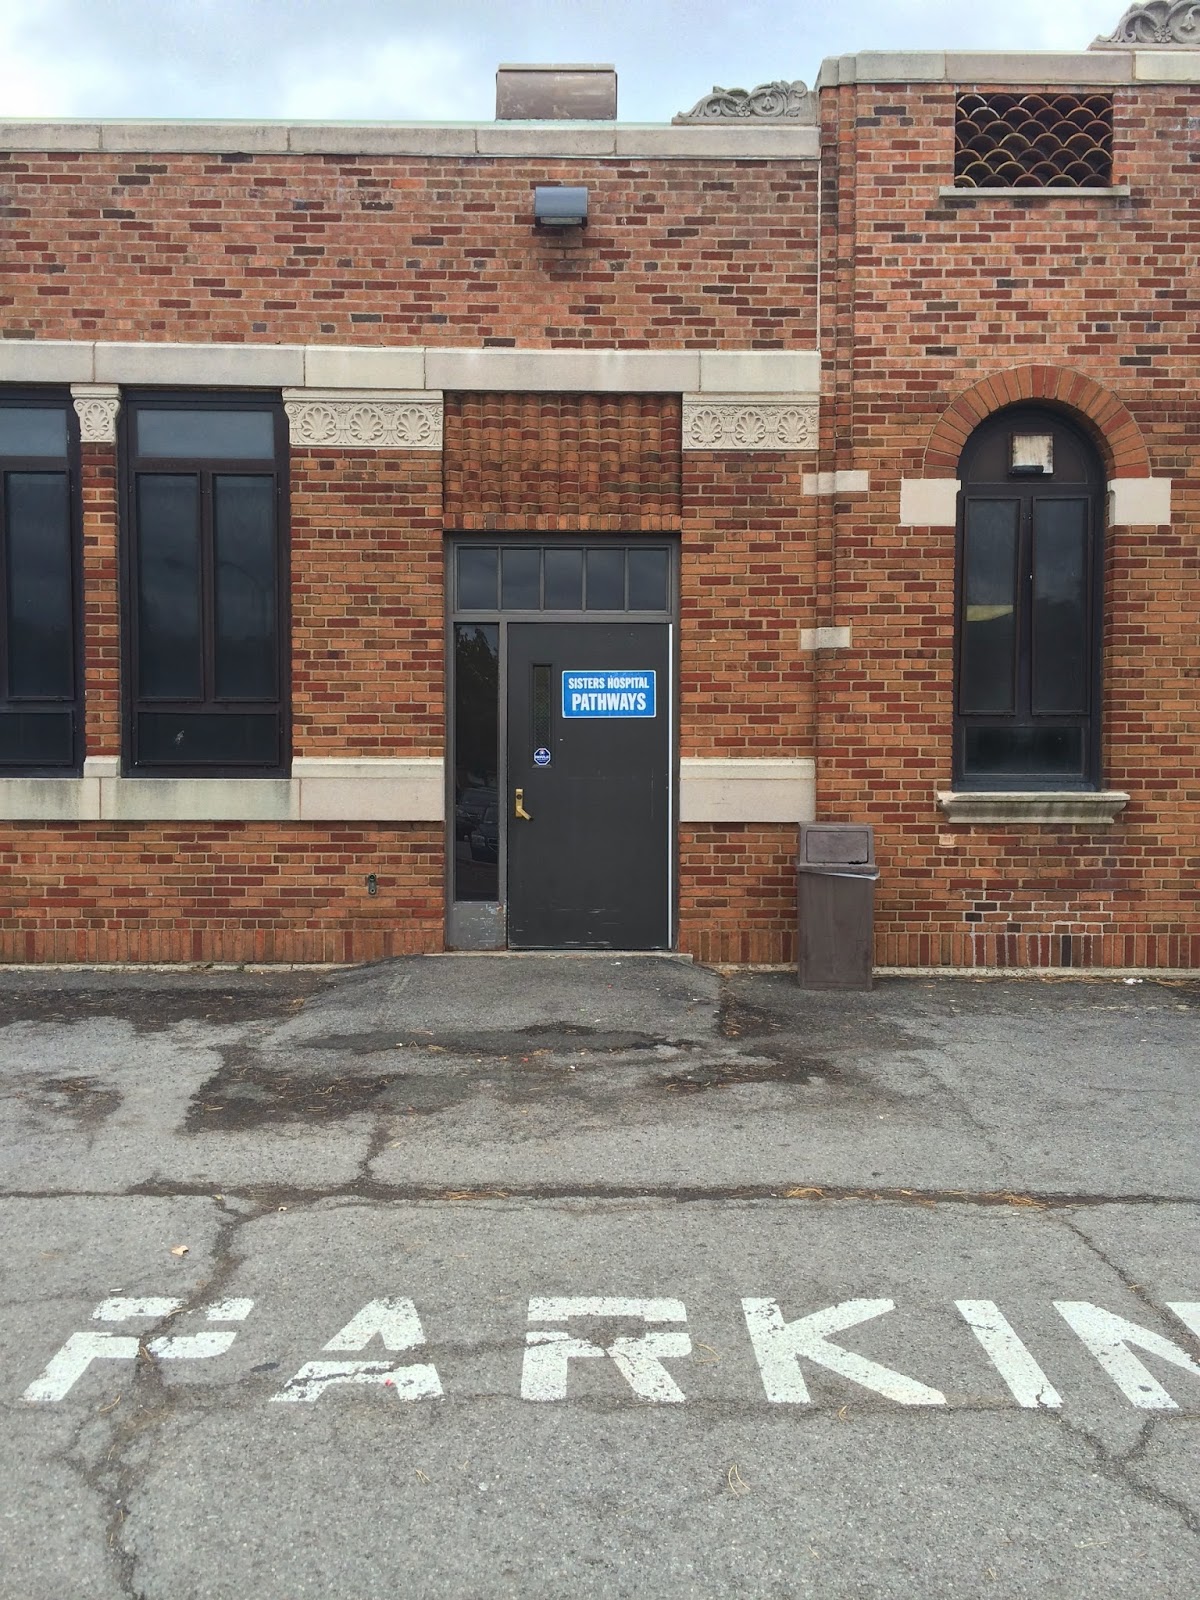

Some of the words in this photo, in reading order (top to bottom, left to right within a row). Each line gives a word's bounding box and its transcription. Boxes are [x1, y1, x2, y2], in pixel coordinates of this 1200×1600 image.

[568, 677, 605, 690] SISTERS
[607, 676, 650, 689] HOSPITAL
[571, 692, 647, 711] PATHWAYS
